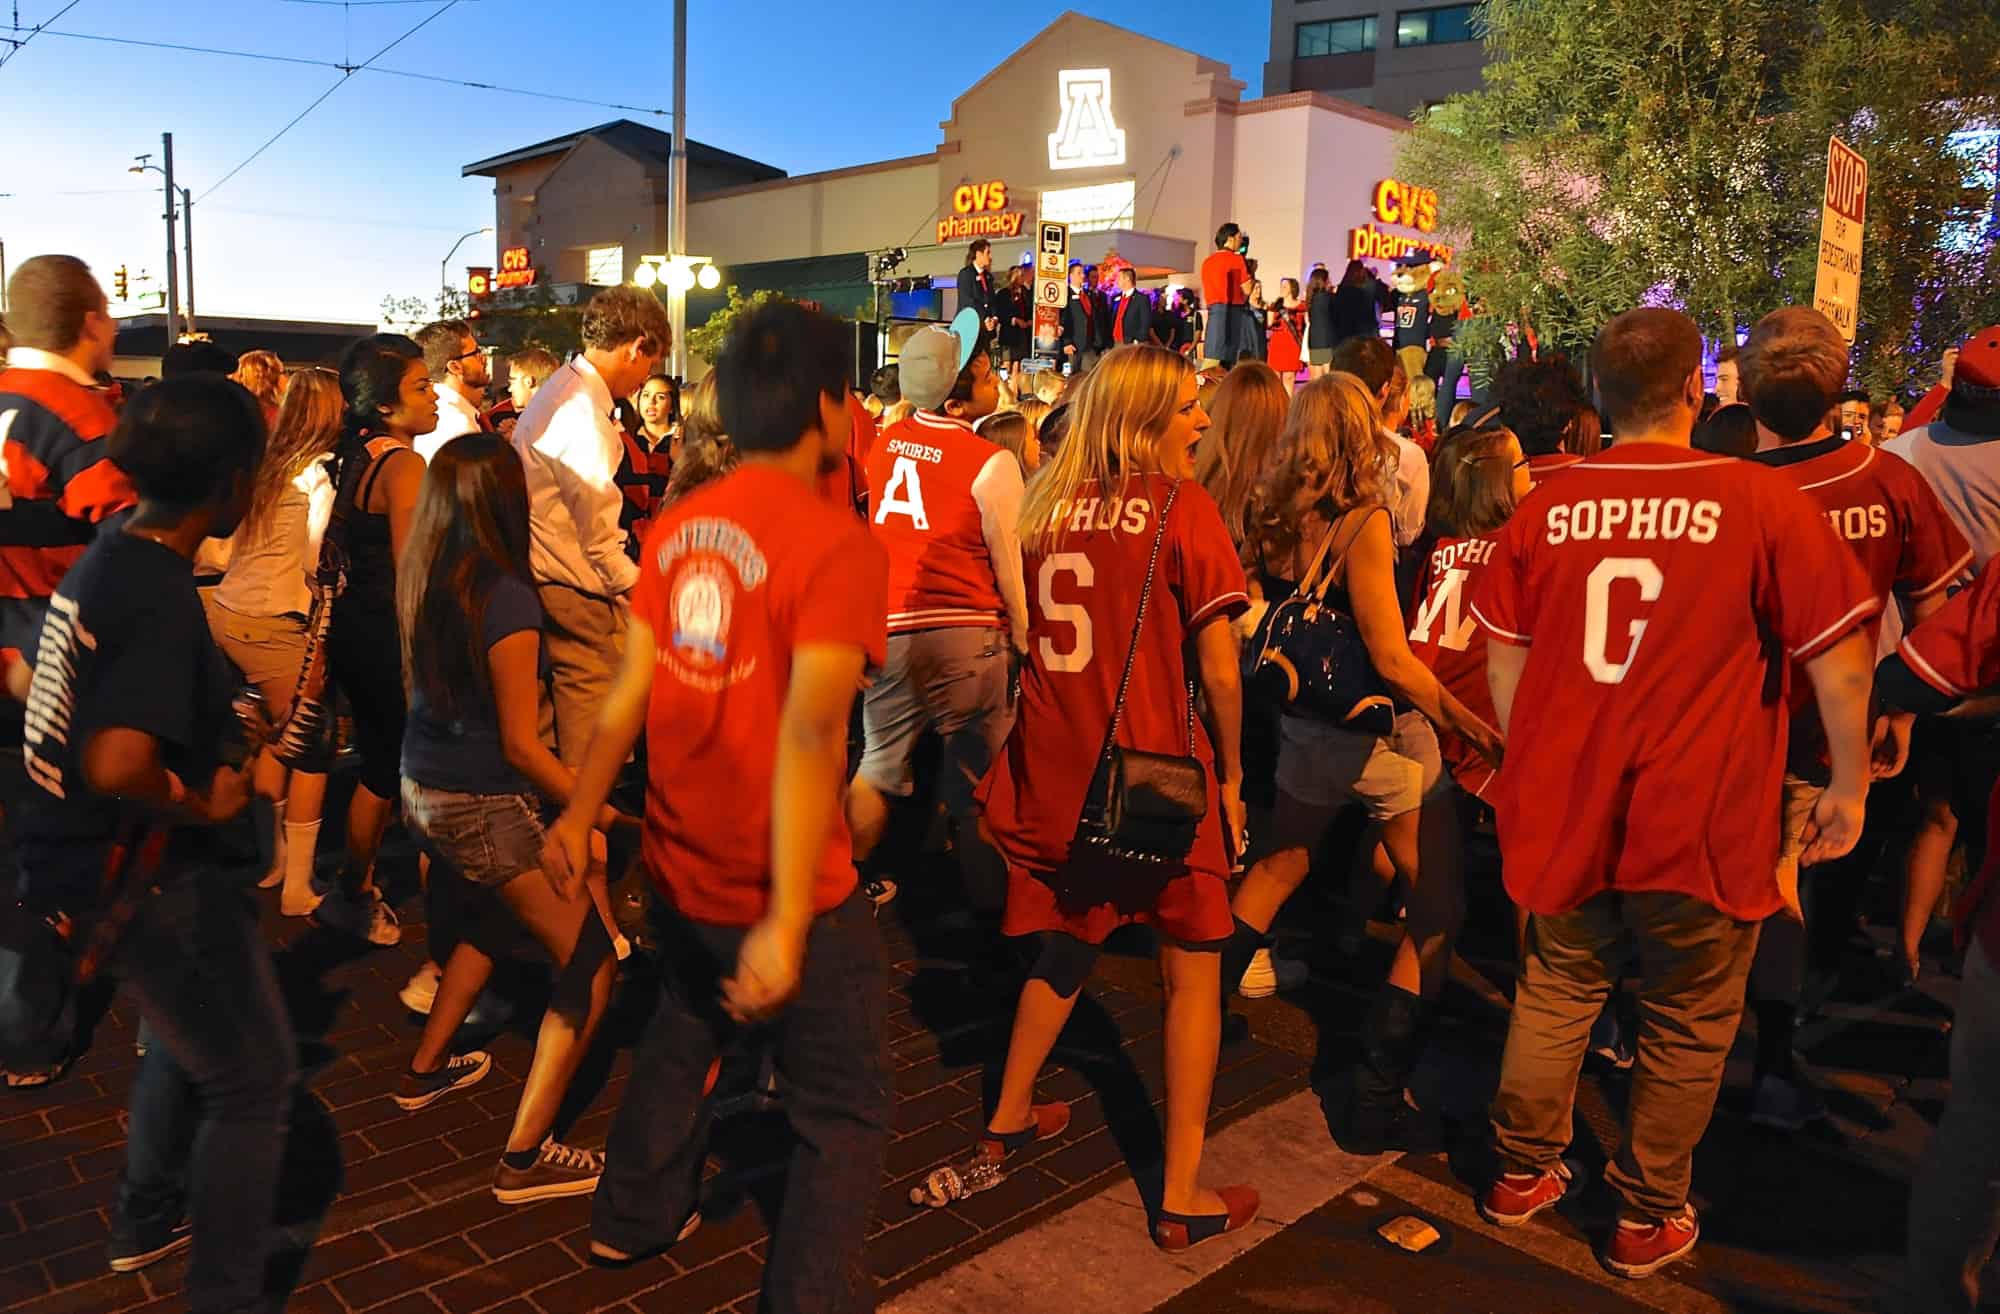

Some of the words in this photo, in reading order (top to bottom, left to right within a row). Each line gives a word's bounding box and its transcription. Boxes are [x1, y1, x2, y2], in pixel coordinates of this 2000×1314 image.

[1048, 69, 1126, 169] A
[954, 180, 1007, 213] CVS
[1374, 178, 1439, 233] CVS
[1828, 145, 1863, 217] STOP
[503, 248, 528, 270] CVS
[938, 212, 1022, 244] pharmacy
[875, 456, 930, 530] A
[1547, 498, 1722, 545] SOPHOS
[1038, 552, 1094, 673] S
[1583, 557, 1664, 685] G
